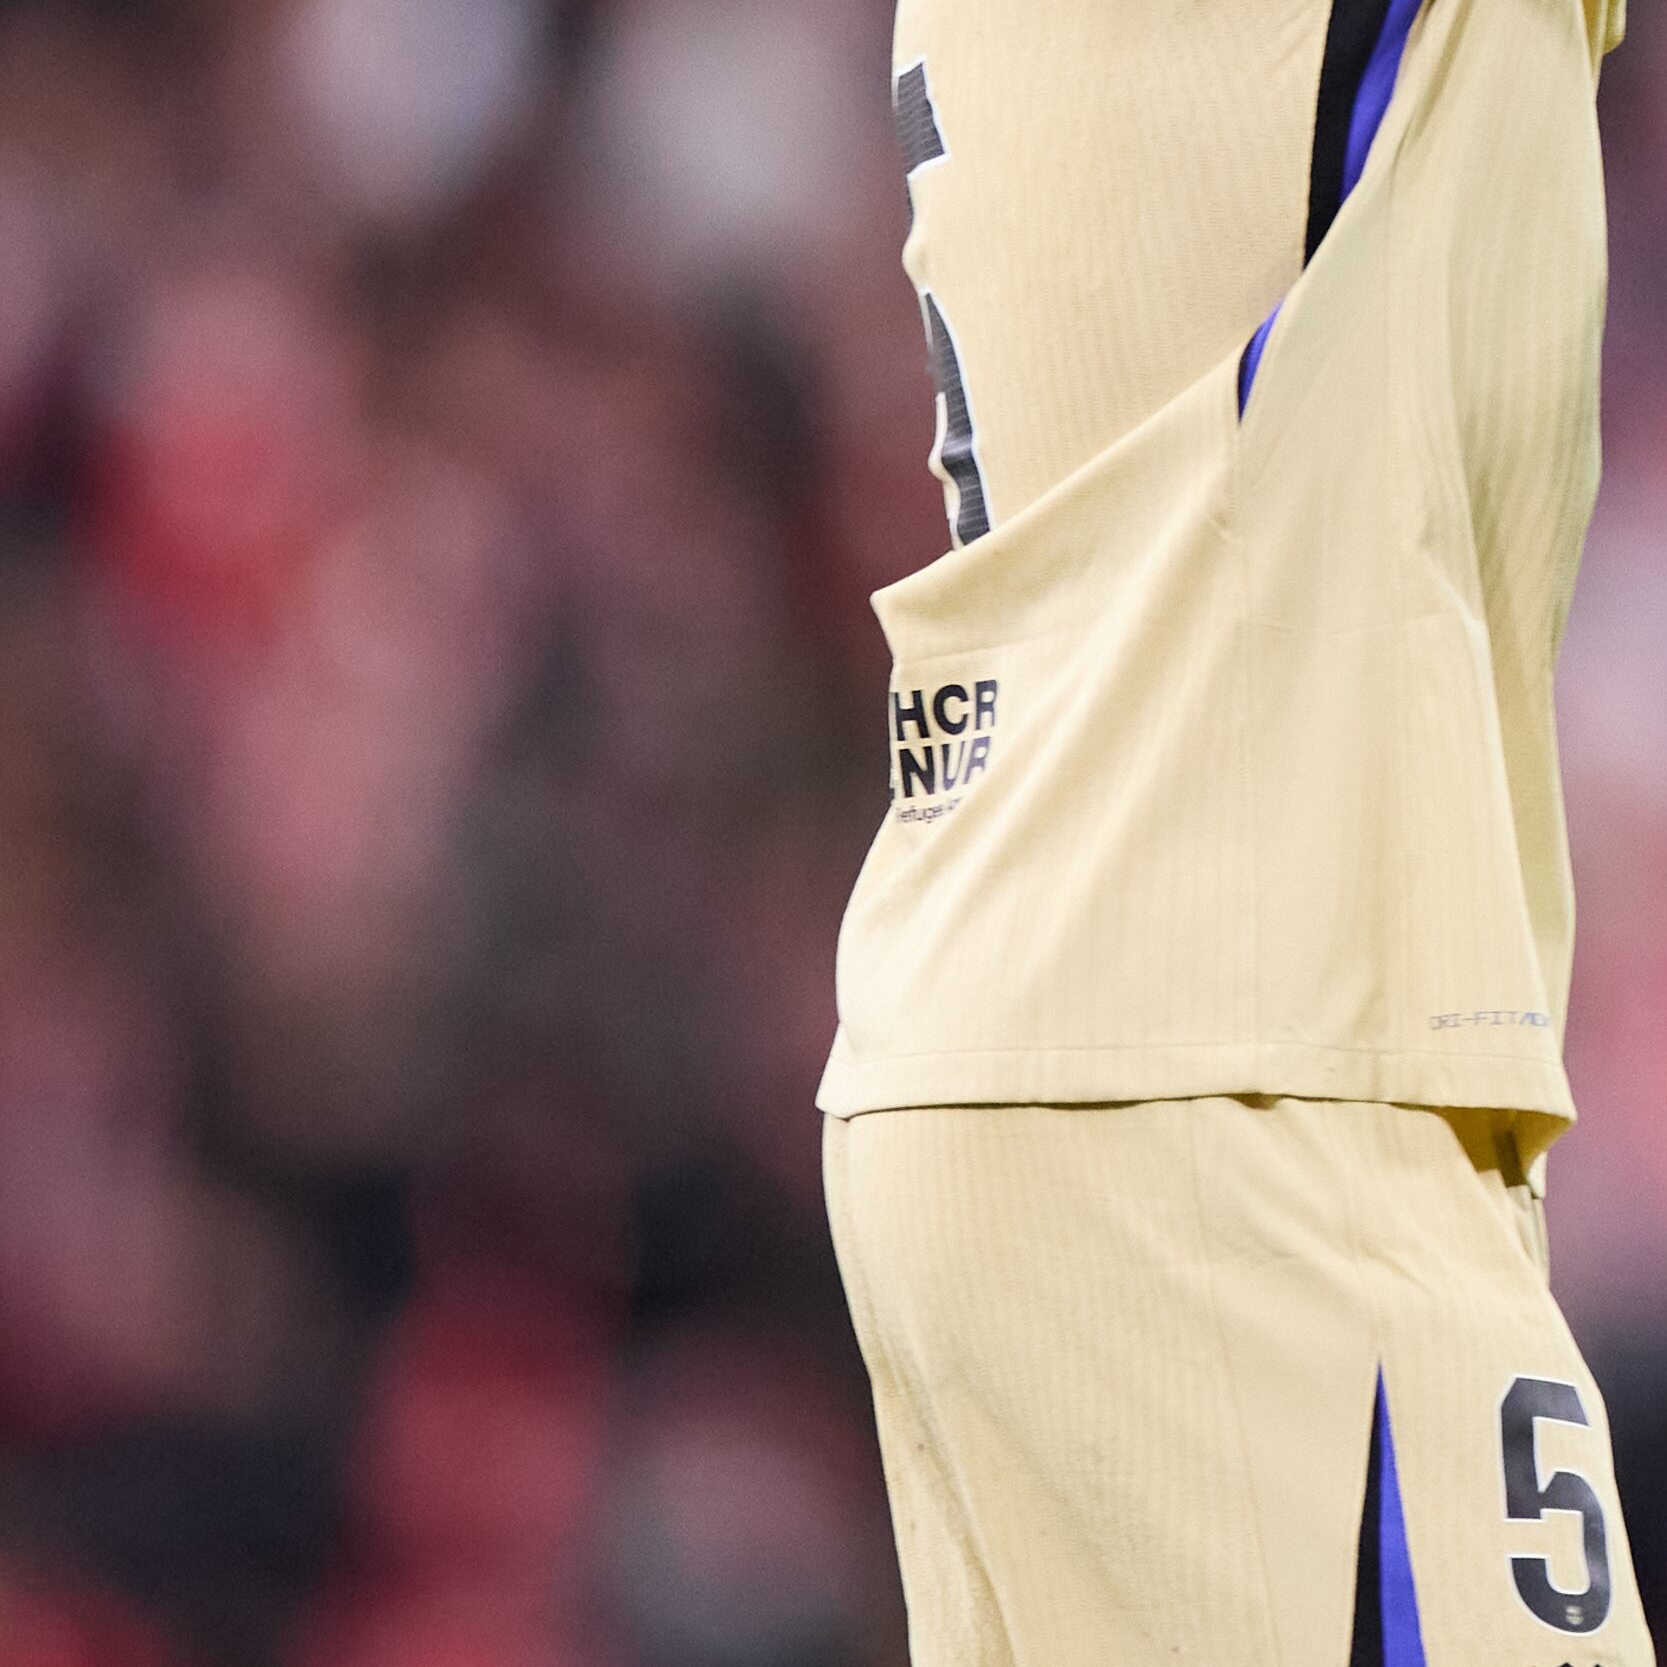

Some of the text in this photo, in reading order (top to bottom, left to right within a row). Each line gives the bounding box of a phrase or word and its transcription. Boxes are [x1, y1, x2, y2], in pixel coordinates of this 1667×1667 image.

[893, 679, 998, 741] HCR
[899, 735, 991, 798] NUR
[1499, 1375, 1613, 1635] 5
